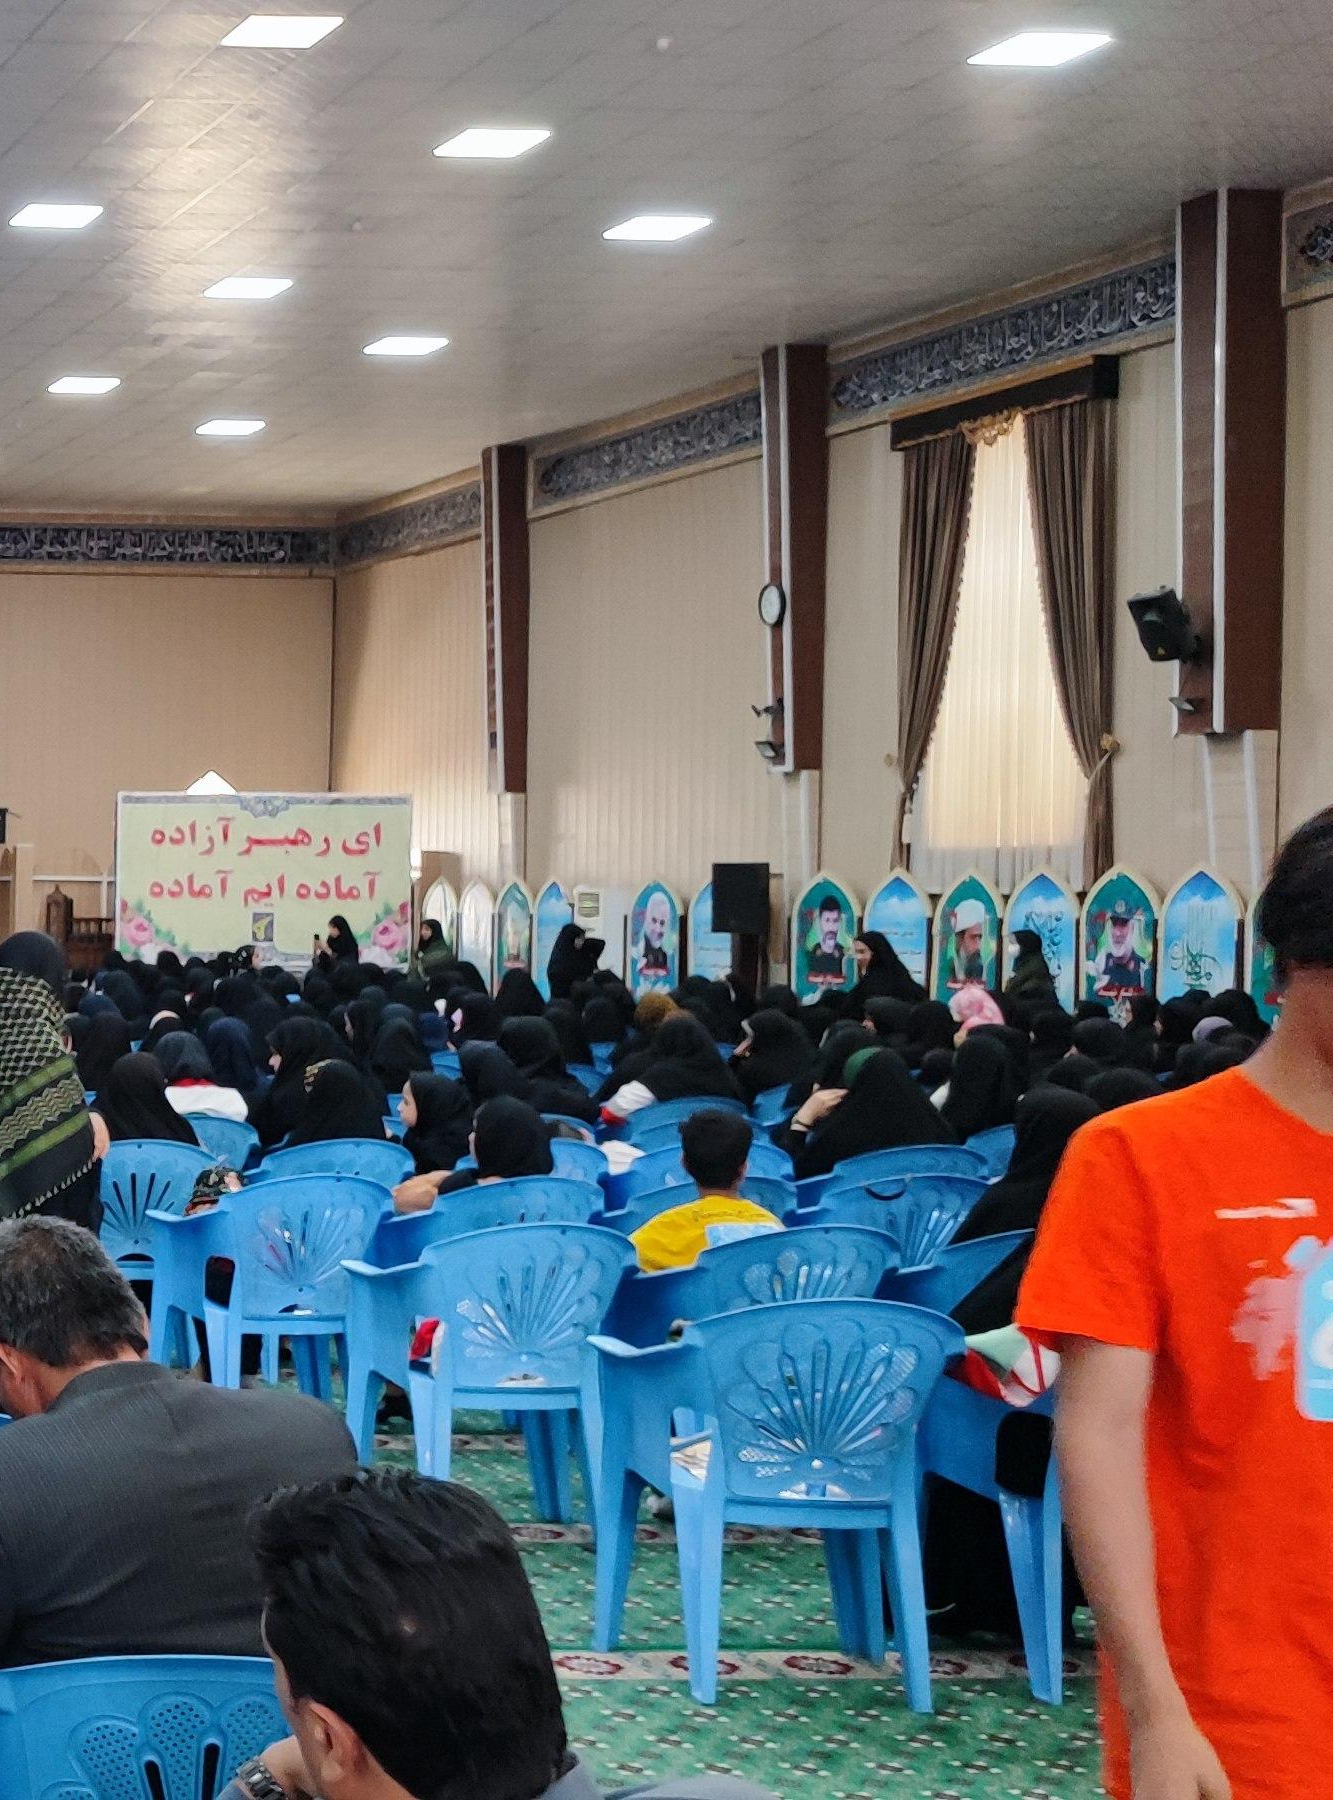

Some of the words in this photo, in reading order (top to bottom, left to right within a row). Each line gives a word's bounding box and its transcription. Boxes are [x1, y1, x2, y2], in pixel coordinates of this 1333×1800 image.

[150, 816, 234, 857] آزاده
[341, 821, 382, 857] ای
[149, 869, 233, 900] آماده
[244, 873, 286, 908] ایم
[295, 871, 382, 901] آماده
